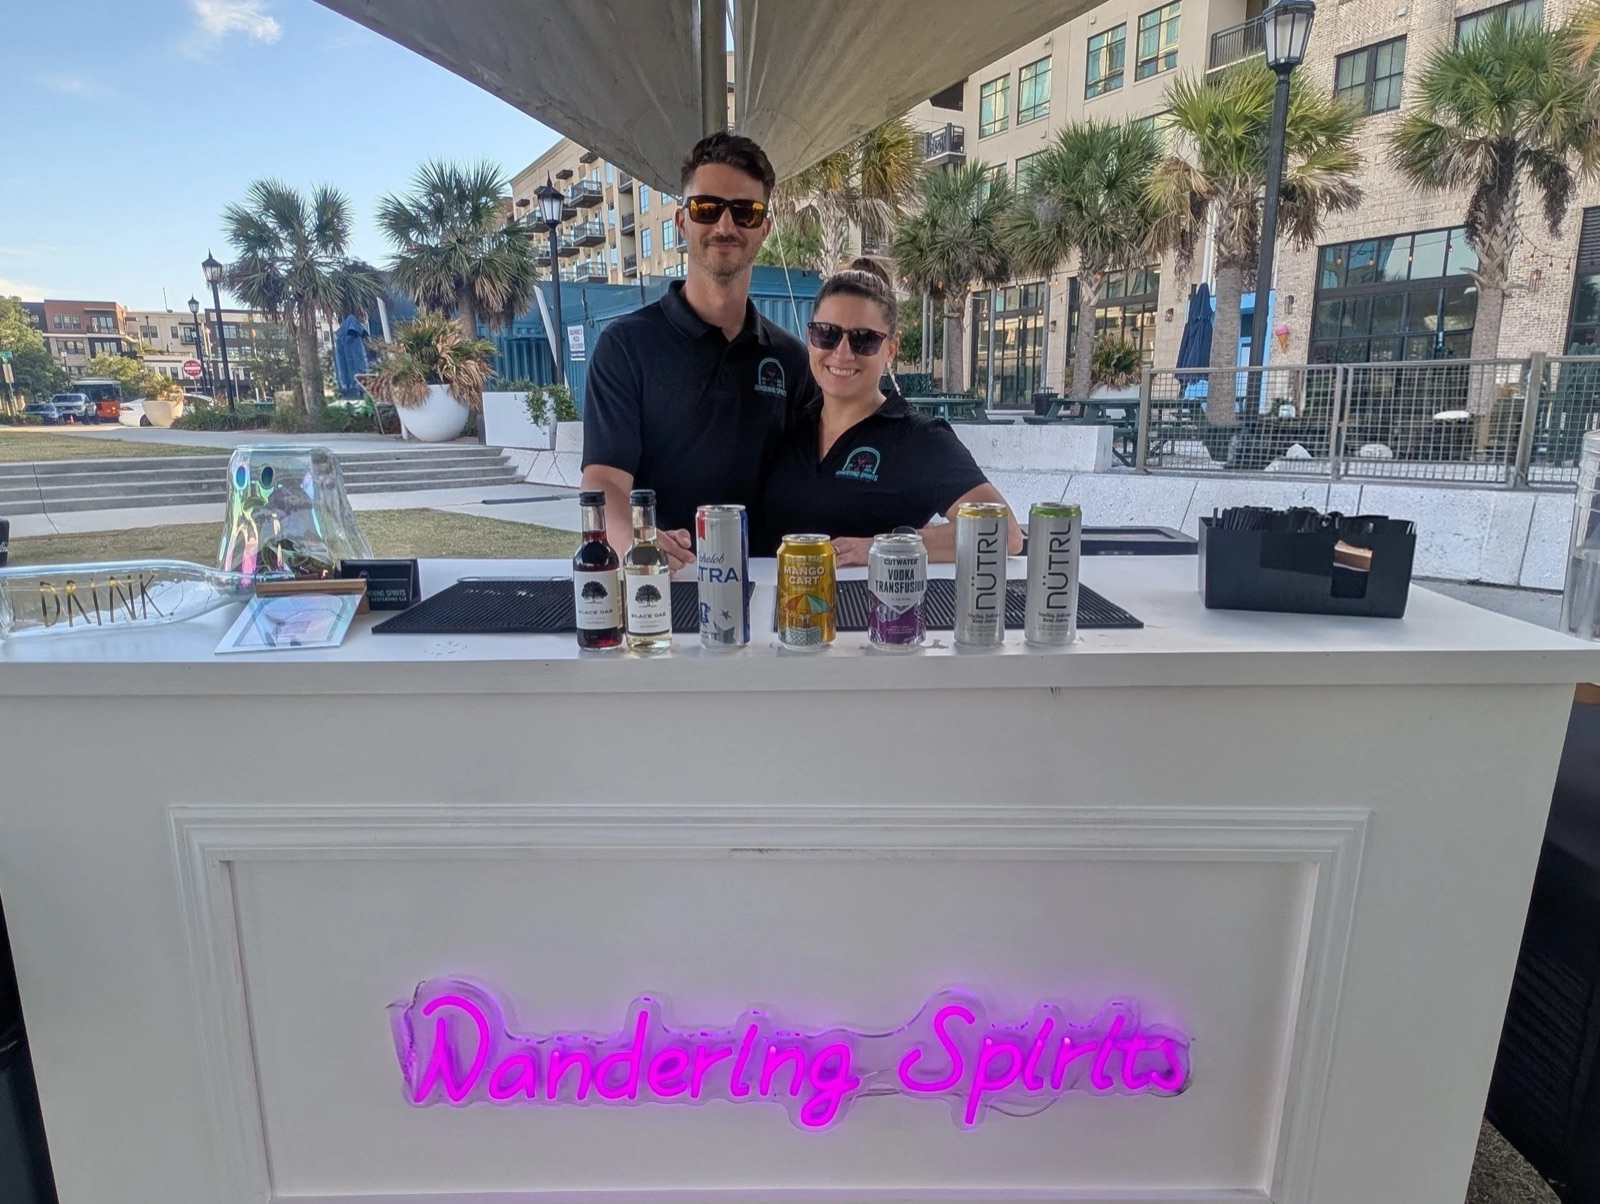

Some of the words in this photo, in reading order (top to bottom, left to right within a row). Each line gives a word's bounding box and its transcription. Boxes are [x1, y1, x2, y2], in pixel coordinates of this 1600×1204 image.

[884, 558, 919, 566] CUTWATER
[698, 566, 739, 583] TRA
[784, 565, 825, 576] MANGO
[888, 569, 915, 580] VODKA
[789, 576, 819, 586] CART
[875, 580, 925, 594] TRANSFUSION
[899, 1005, 1183, 1125] Spirits
